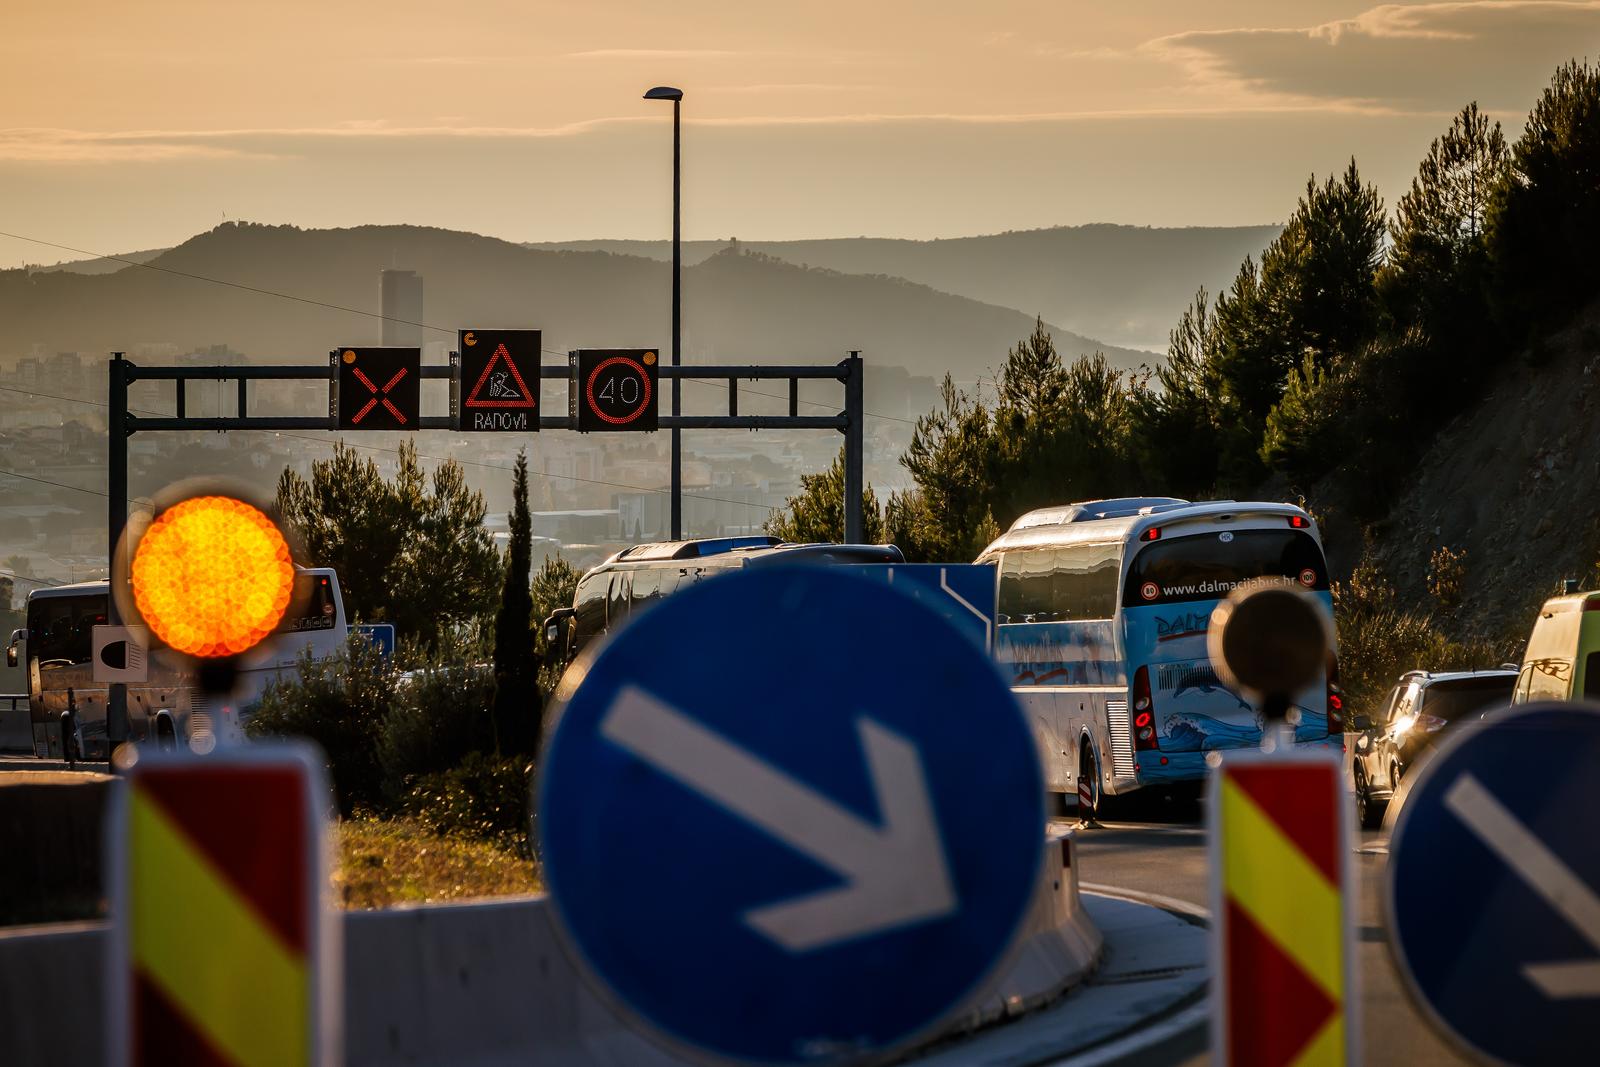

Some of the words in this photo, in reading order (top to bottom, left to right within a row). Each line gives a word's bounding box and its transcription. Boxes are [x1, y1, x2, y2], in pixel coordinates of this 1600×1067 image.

[599, 377, 638, 404] 40
[1163, 574, 1296, 597] www.dalmacijabus.hr
[1155, 612, 1210, 636] DALM
